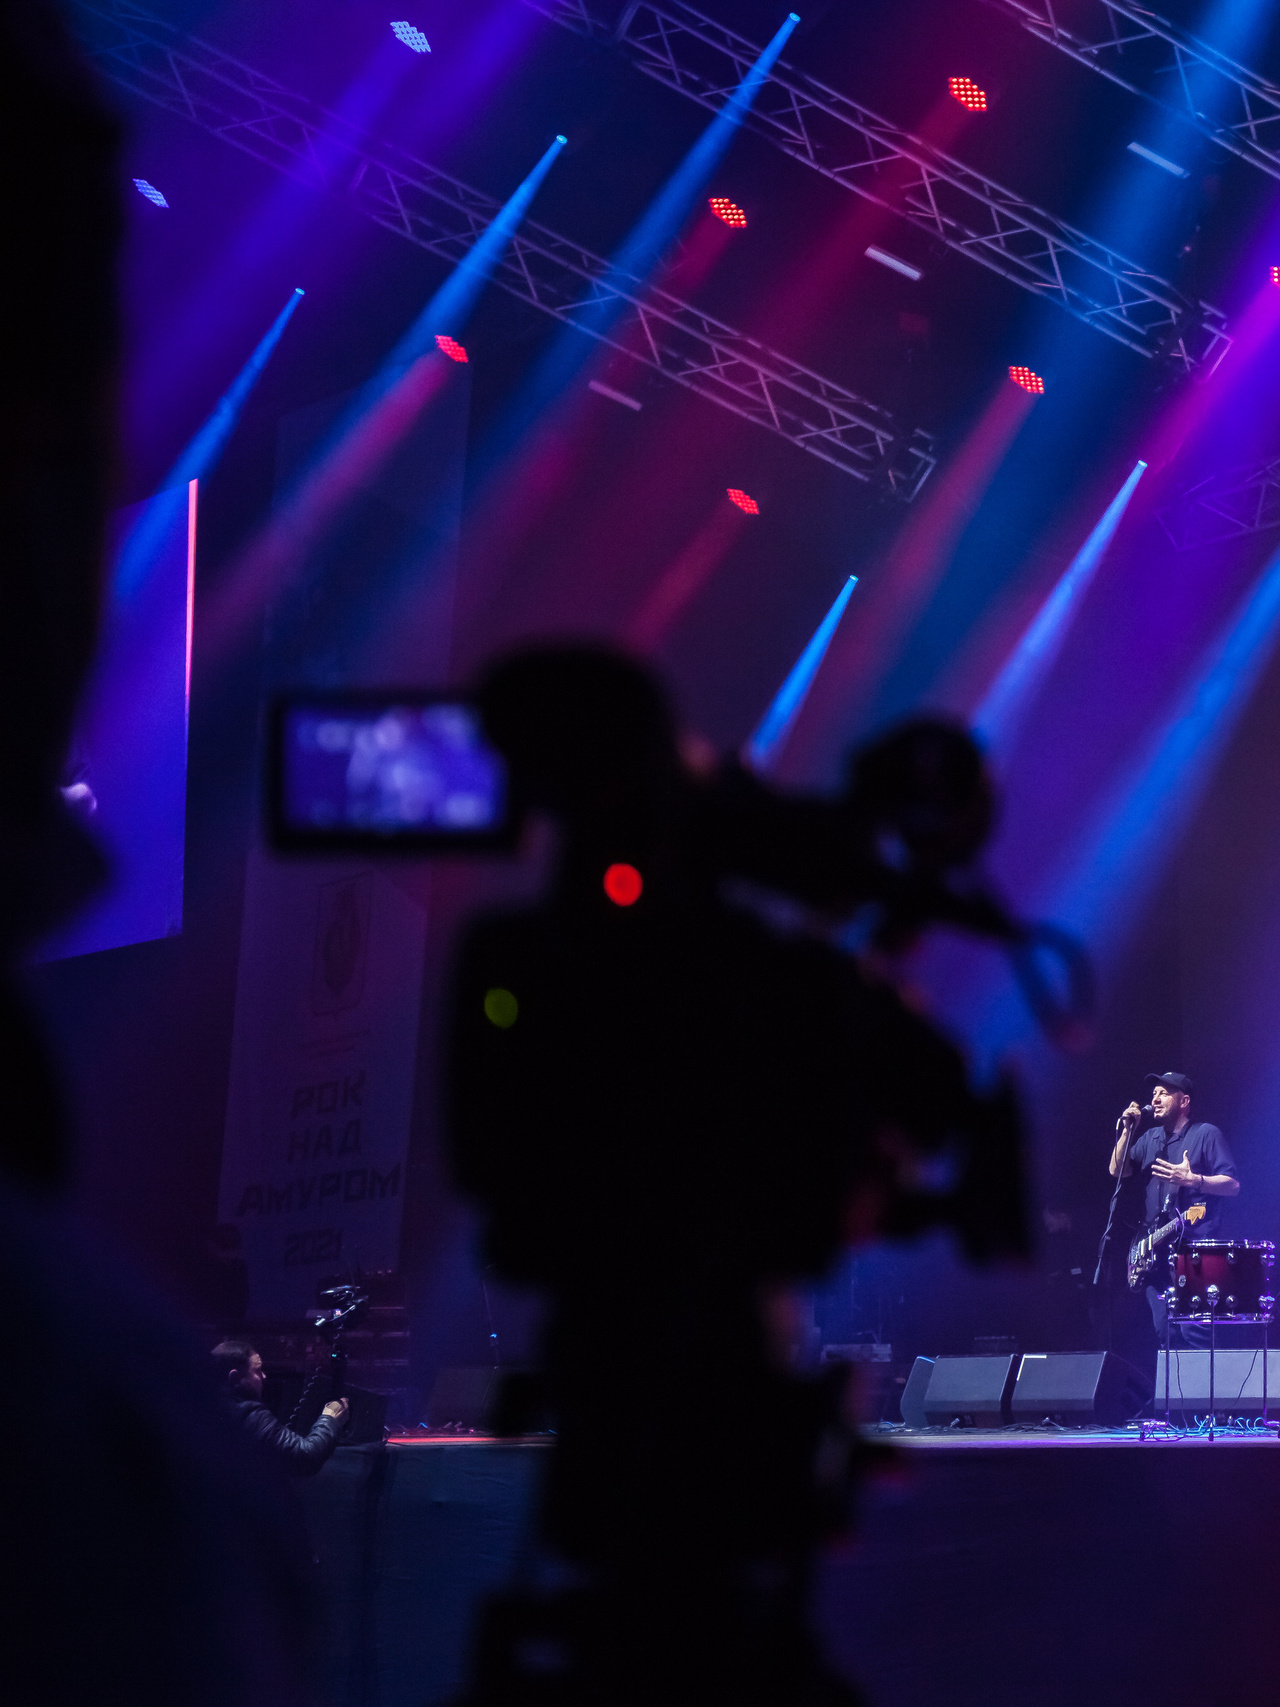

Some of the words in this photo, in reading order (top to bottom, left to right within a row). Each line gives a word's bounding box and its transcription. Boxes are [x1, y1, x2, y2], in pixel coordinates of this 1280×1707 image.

[291, 1071, 366, 1119] РОК
[288, 1119, 362, 1163] НАД
[236, 1164, 400, 1217] АМУРОМ
[283, 1228, 343, 1267] 2021
